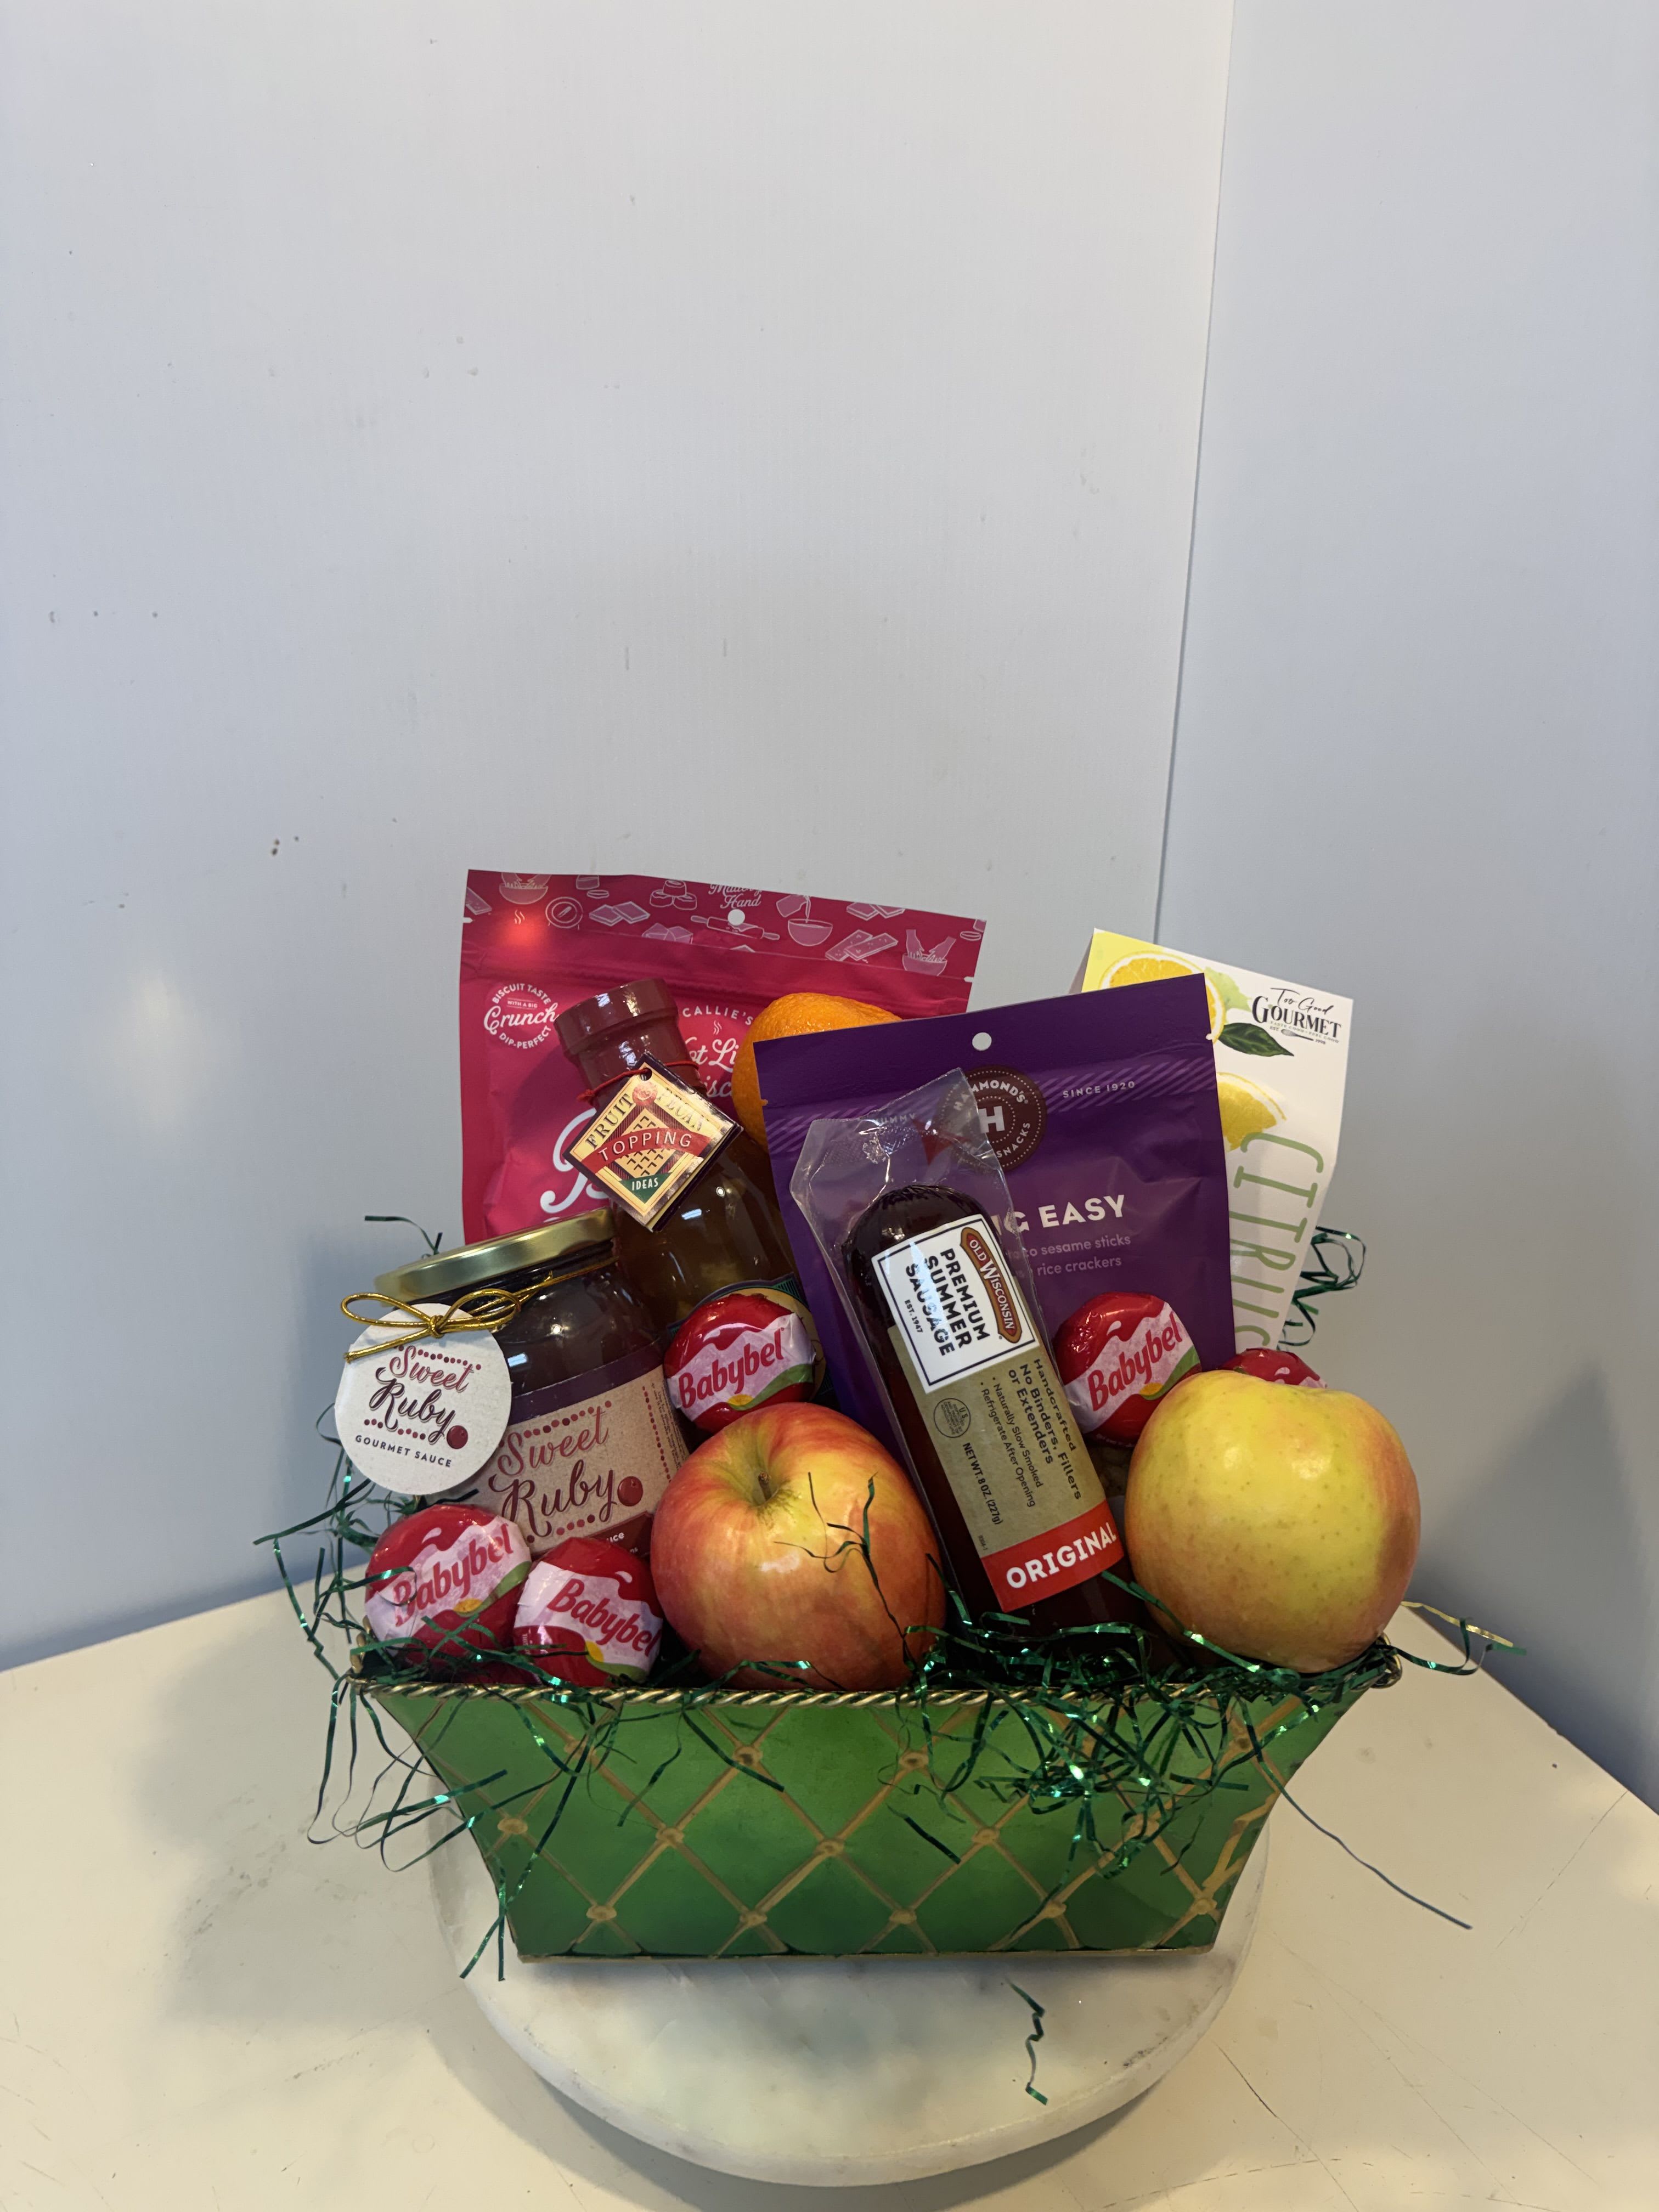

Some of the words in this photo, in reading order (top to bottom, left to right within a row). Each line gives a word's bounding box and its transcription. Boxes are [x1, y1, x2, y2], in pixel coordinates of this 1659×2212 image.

[720, 893, 761, 909] Hand
[484, 1002, 560, 1035] Crunch
[492, 983, 524, 1003] BISCUIT
[527, 984, 551, 1005] TASTE
[682, 1005, 754, 1025] CALLIE'S
[1252, 996, 1341, 1038] GOURMET
[1270, 988, 1300, 1006] Too
[1297, 997, 1334, 1015] Good
[499, 1025, 551, 1049] DIP-PERFECT
[657, 1086, 709, 1131] PECAN
[1062, 1085, 1101, 1098] SINCE
[1107, 1081, 1135, 1092] 1920
[585, 1093, 634, 1149] FRUIT
[978, 1106, 1005, 1133] H
[996, 1122, 1031, 1158] SNACKS
[598, 1131, 692, 1161] TOPPING
[631, 1177, 659, 1191] IDEAS
[1038, 1194, 1125, 1228] EASY
[1037, 1263, 1062, 1277] rice
[1065, 1256, 1122, 1273] crackers
[1041, 1239, 1091, 1256] sesame
[1094, 1234, 1131, 1249] sticks
[906, 1263, 955, 1356] SAUSAGE
[924, 1255, 973, 1348] SUMMER
[940, 1248, 990, 1341] PREMIUM
[969, 1239, 987, 1261] OLD
[979, 1260, 1015, 1330] WISCONSIN
[905, 1299, 915, 1316] EST.
[911, 1316, 923, 1333] 1947
[389, 1345, 475, 1393] Sweet
[678, 1327, 784, 1409] Babybel
[1087, 1310, 1183, 1412] Babybel
[368, 1366, 456, 1445] Ruby
[1008, 1369, 1020, 1385] or
[1017, 1387, 1053, 1464] Extenders
[1034, 1358, 1076, 1451] Handcrafted
[355, 1434, 411, 1457] GOURMET
[414, 1451, 452, 1468] SAUCE
[496, 1406, 610, 1476] Sweet
[981, 1388, 1007, 1441] Refrigerate
[1003, 1441, 1019, 1466] After
[1015, 1467, 1036, 1508] Opening
[994, 1383, 1015, 1425] Naturally
[1012, 1426, 1026, 1449] Slow
[1022, 1449, 1043, 1488] Smoked
[1020, 1363, 1032, 1385] No
[1030, 1387, 1058, 1450] Binders,
[1058, 1452, 1081, 1500] Fillers
[488, 1459, 618, 1538] Ruby
[963, 1442, 977, 1460] NET
[970, 1460, 983, 1479] WT.
[985, 1499, 1003, 1525] (227g)
[393, 1522, 514, 1627] Babybel
[1006, 1522, 1117, 1589] ORIGINAL
[546, 1578, 662, 1657] Babybel
